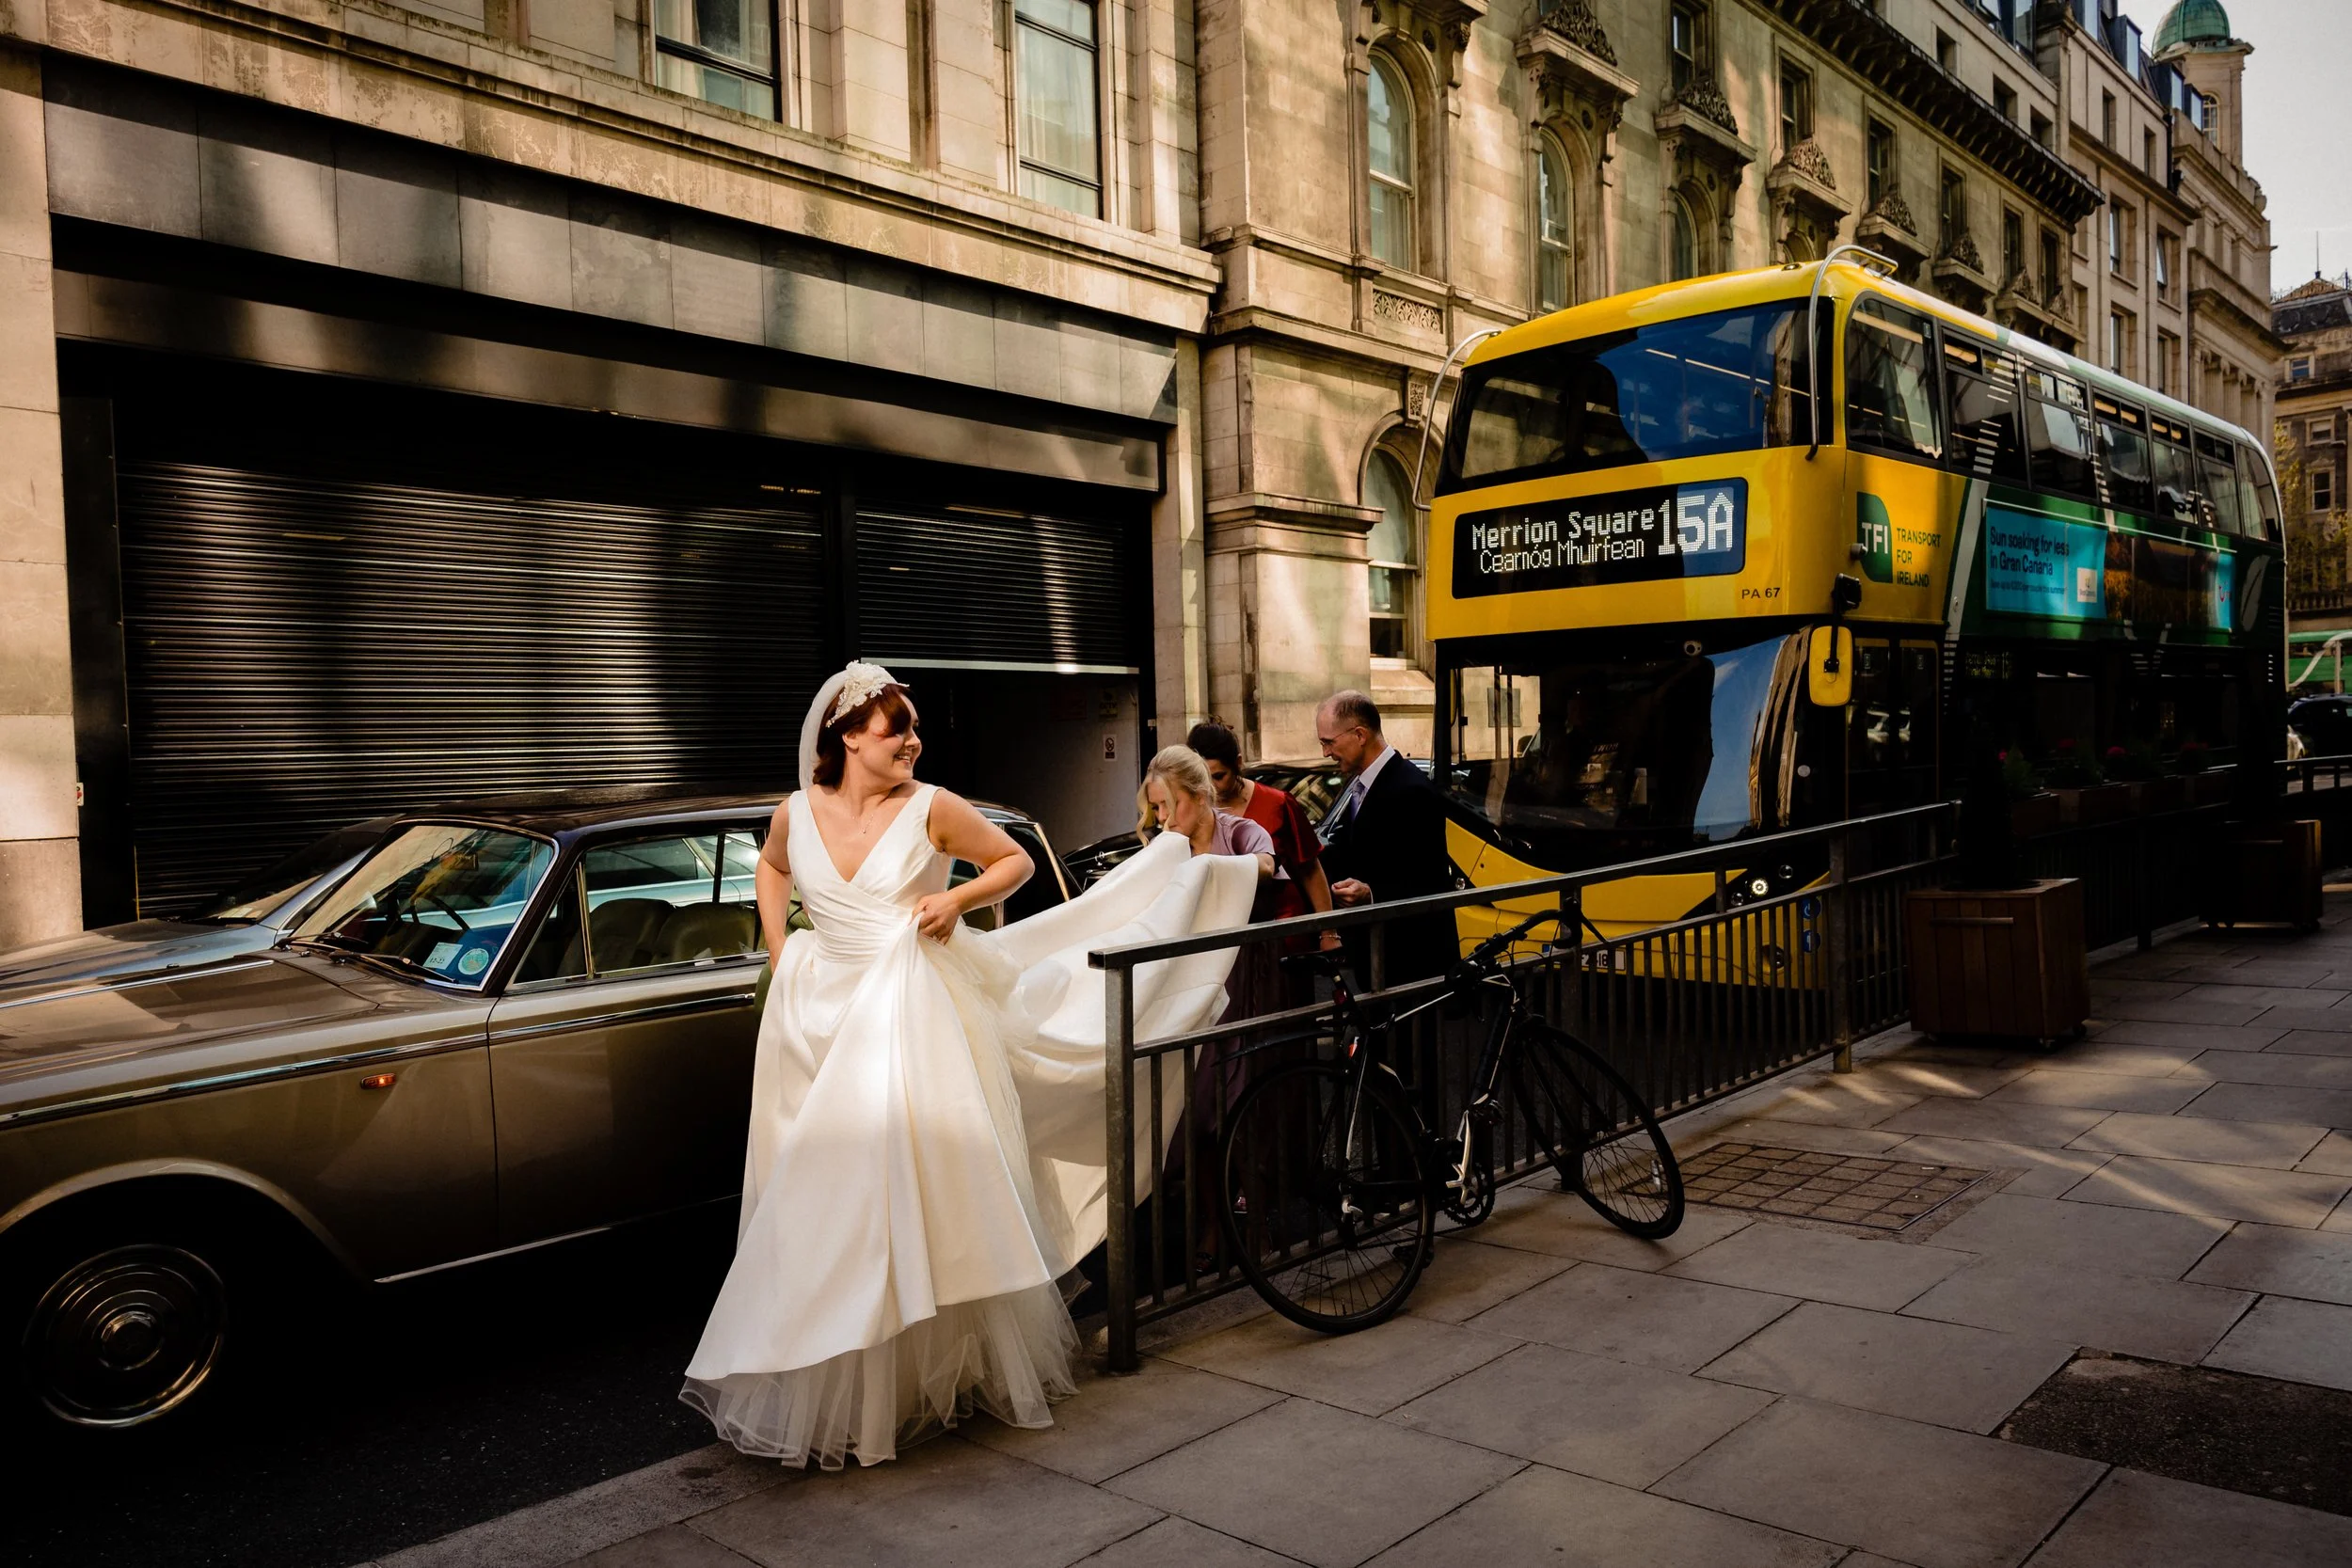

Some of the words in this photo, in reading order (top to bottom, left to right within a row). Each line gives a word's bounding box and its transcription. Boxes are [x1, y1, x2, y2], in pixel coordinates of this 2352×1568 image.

[1472, 517, 1558, 550] Merrion
[1568, 508, 1655, 539] Square
[1658, 492, 1734, 556] 15A
[1897, 528, 1942, 548] TRANSPORT
[1861, 522, 1889, 555] TFI
[1990, 527, 2007, 546] Sun
[2009, 531, 2040, 557] soaking
[2041, 534, 2053, 554] for
[2054, 537, 2070, 557] less
[1480, 544, 1551, 574] Cearnóg
[1557, 536, 1645, 566] Mhuirfean
[1897, 549, 1913, 565] FOR
[1990, 549, 1998, 569] in
[1999, 552, 2021, 572] Gran
[2023, 554, 2053, 576] Canaria
[1741, 589, 1761, 599] PA
[1765, 587, 1781, 598] 67
[1897, 570, 1930, 588] IRELAND
